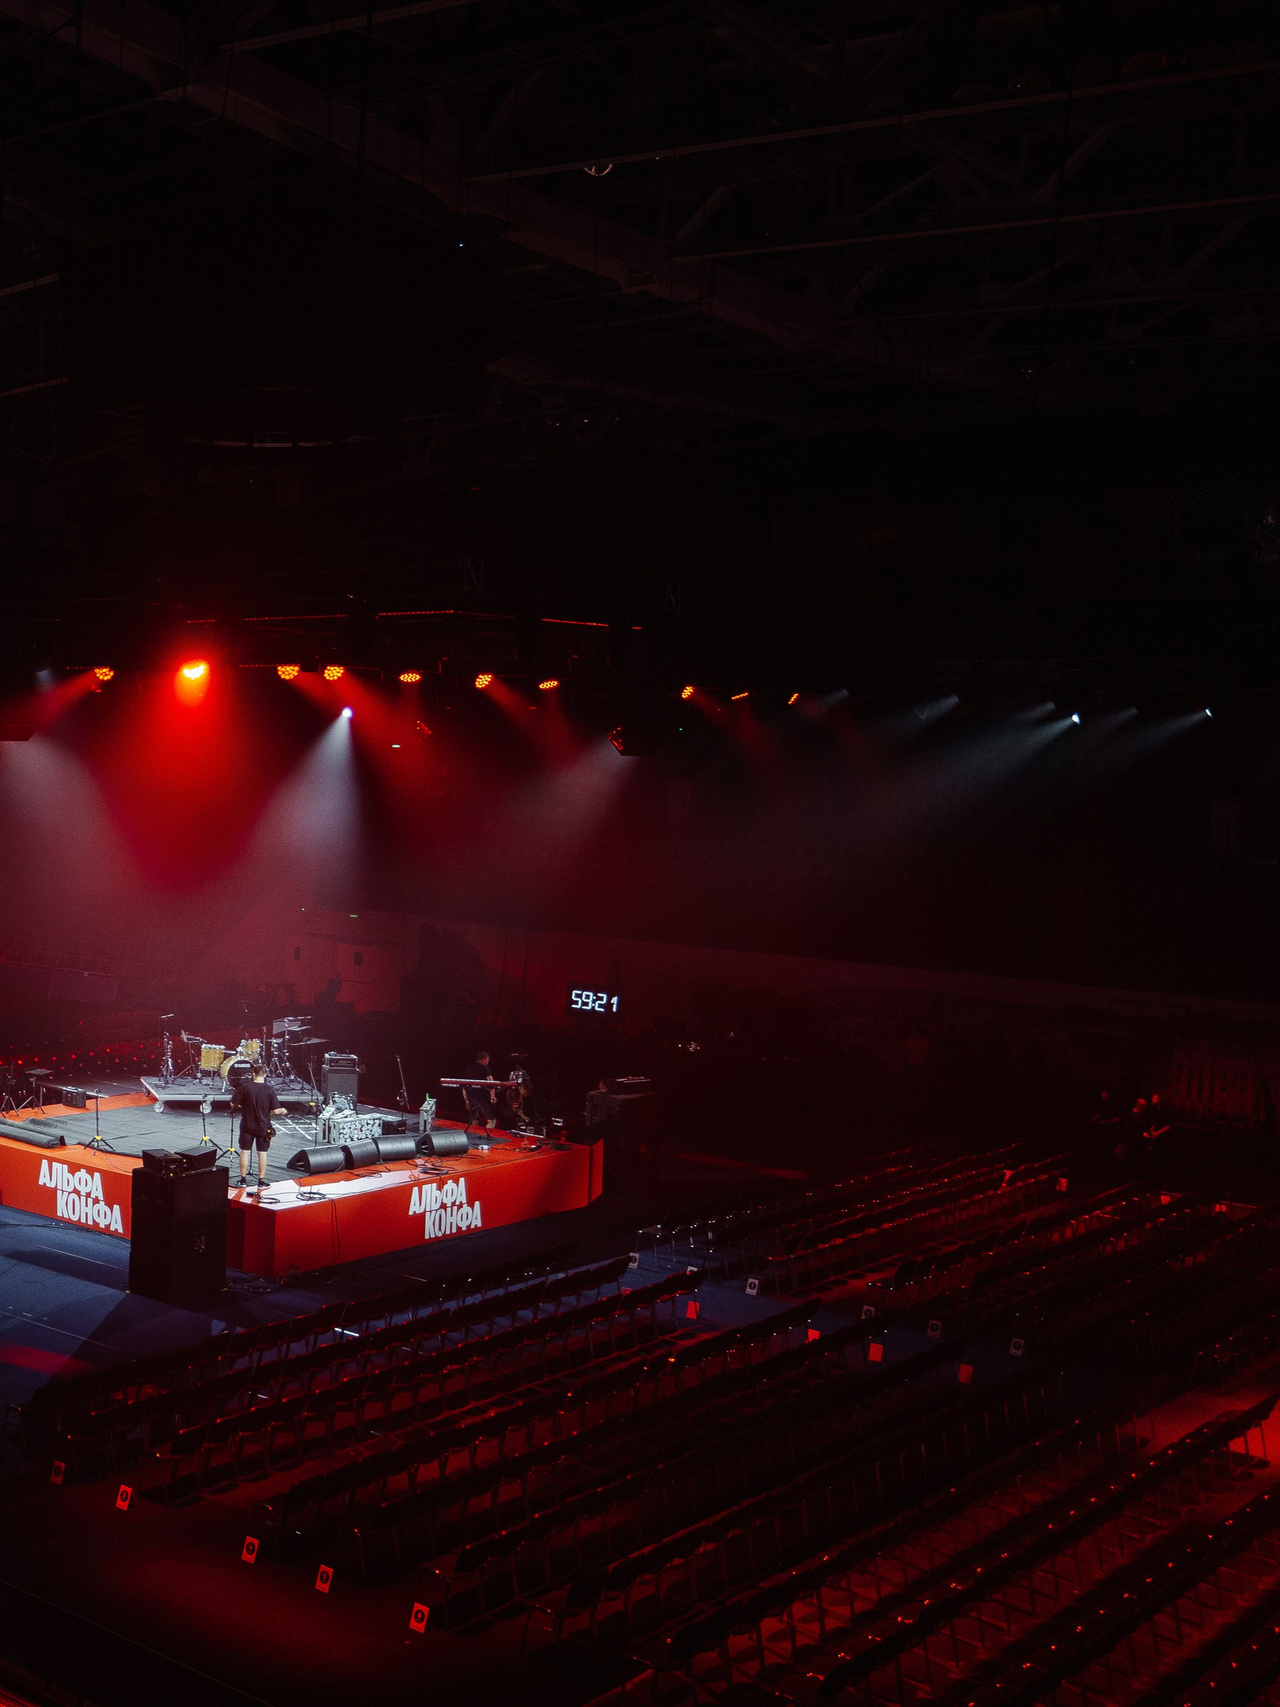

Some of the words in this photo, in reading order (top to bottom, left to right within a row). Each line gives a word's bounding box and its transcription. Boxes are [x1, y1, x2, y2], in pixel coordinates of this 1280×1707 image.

[571, 989, 619, 1013] 59:21
[38, 1159, 104, 1201] АЛЬФА
[408, 1177, 467, 1215] АЛЬФА
[56, 1190, 124, 1234] КОНФА
[424, 1201, 482, 1239] КОНФА
